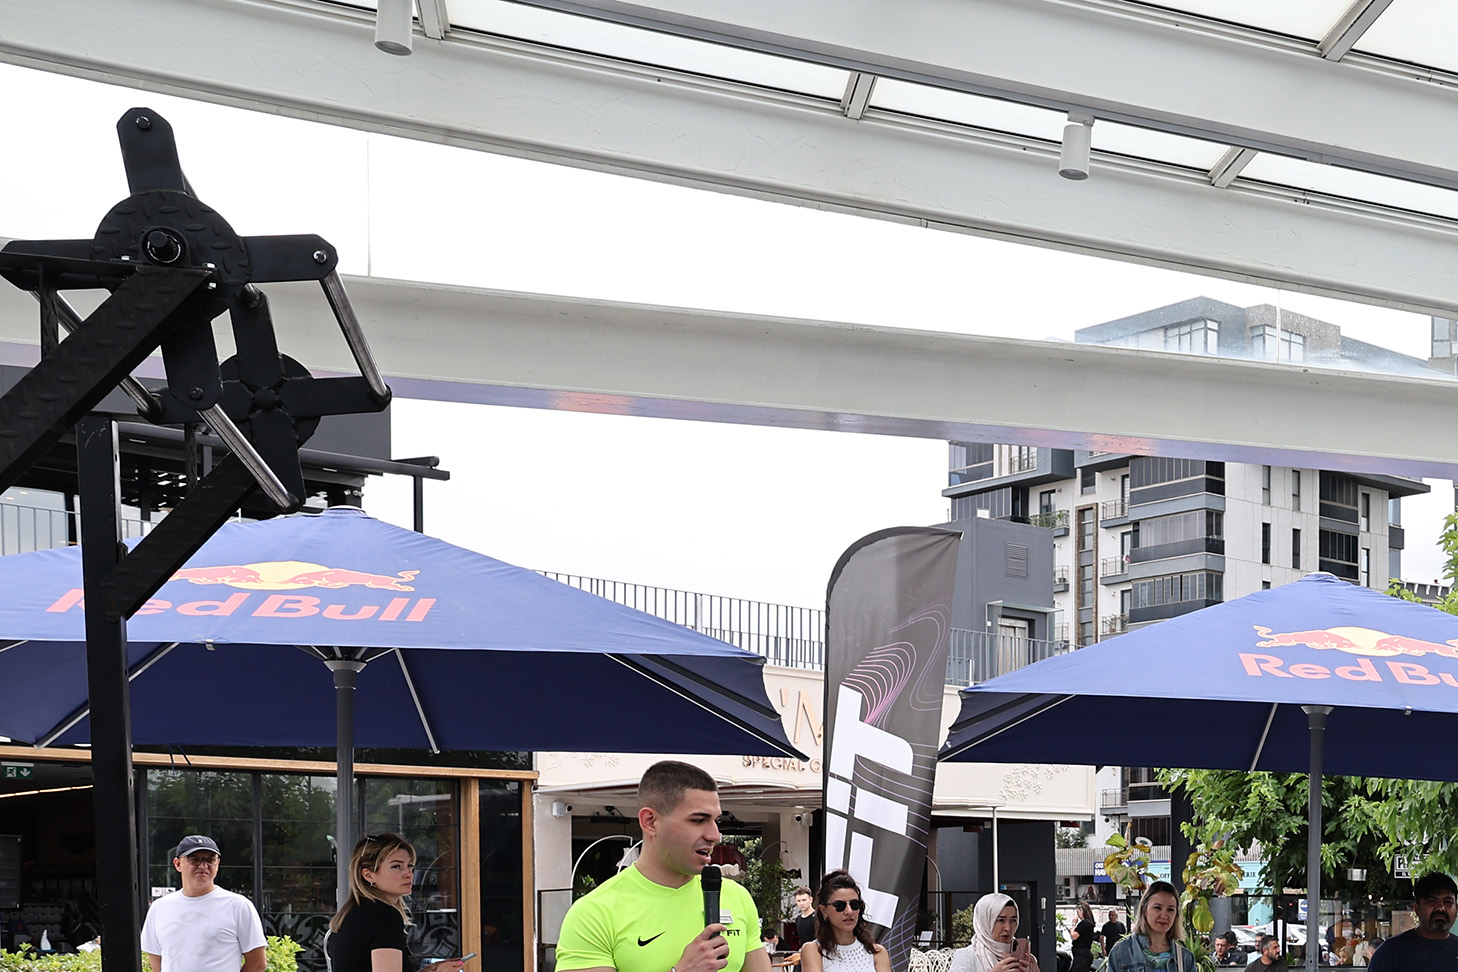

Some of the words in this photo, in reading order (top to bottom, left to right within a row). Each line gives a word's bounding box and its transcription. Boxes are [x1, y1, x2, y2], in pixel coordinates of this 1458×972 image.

[251, 593, 438, 623] Bull
[1237, 652, 1384, 683] Red
[742, 755, 806, 771] SPECIAL
